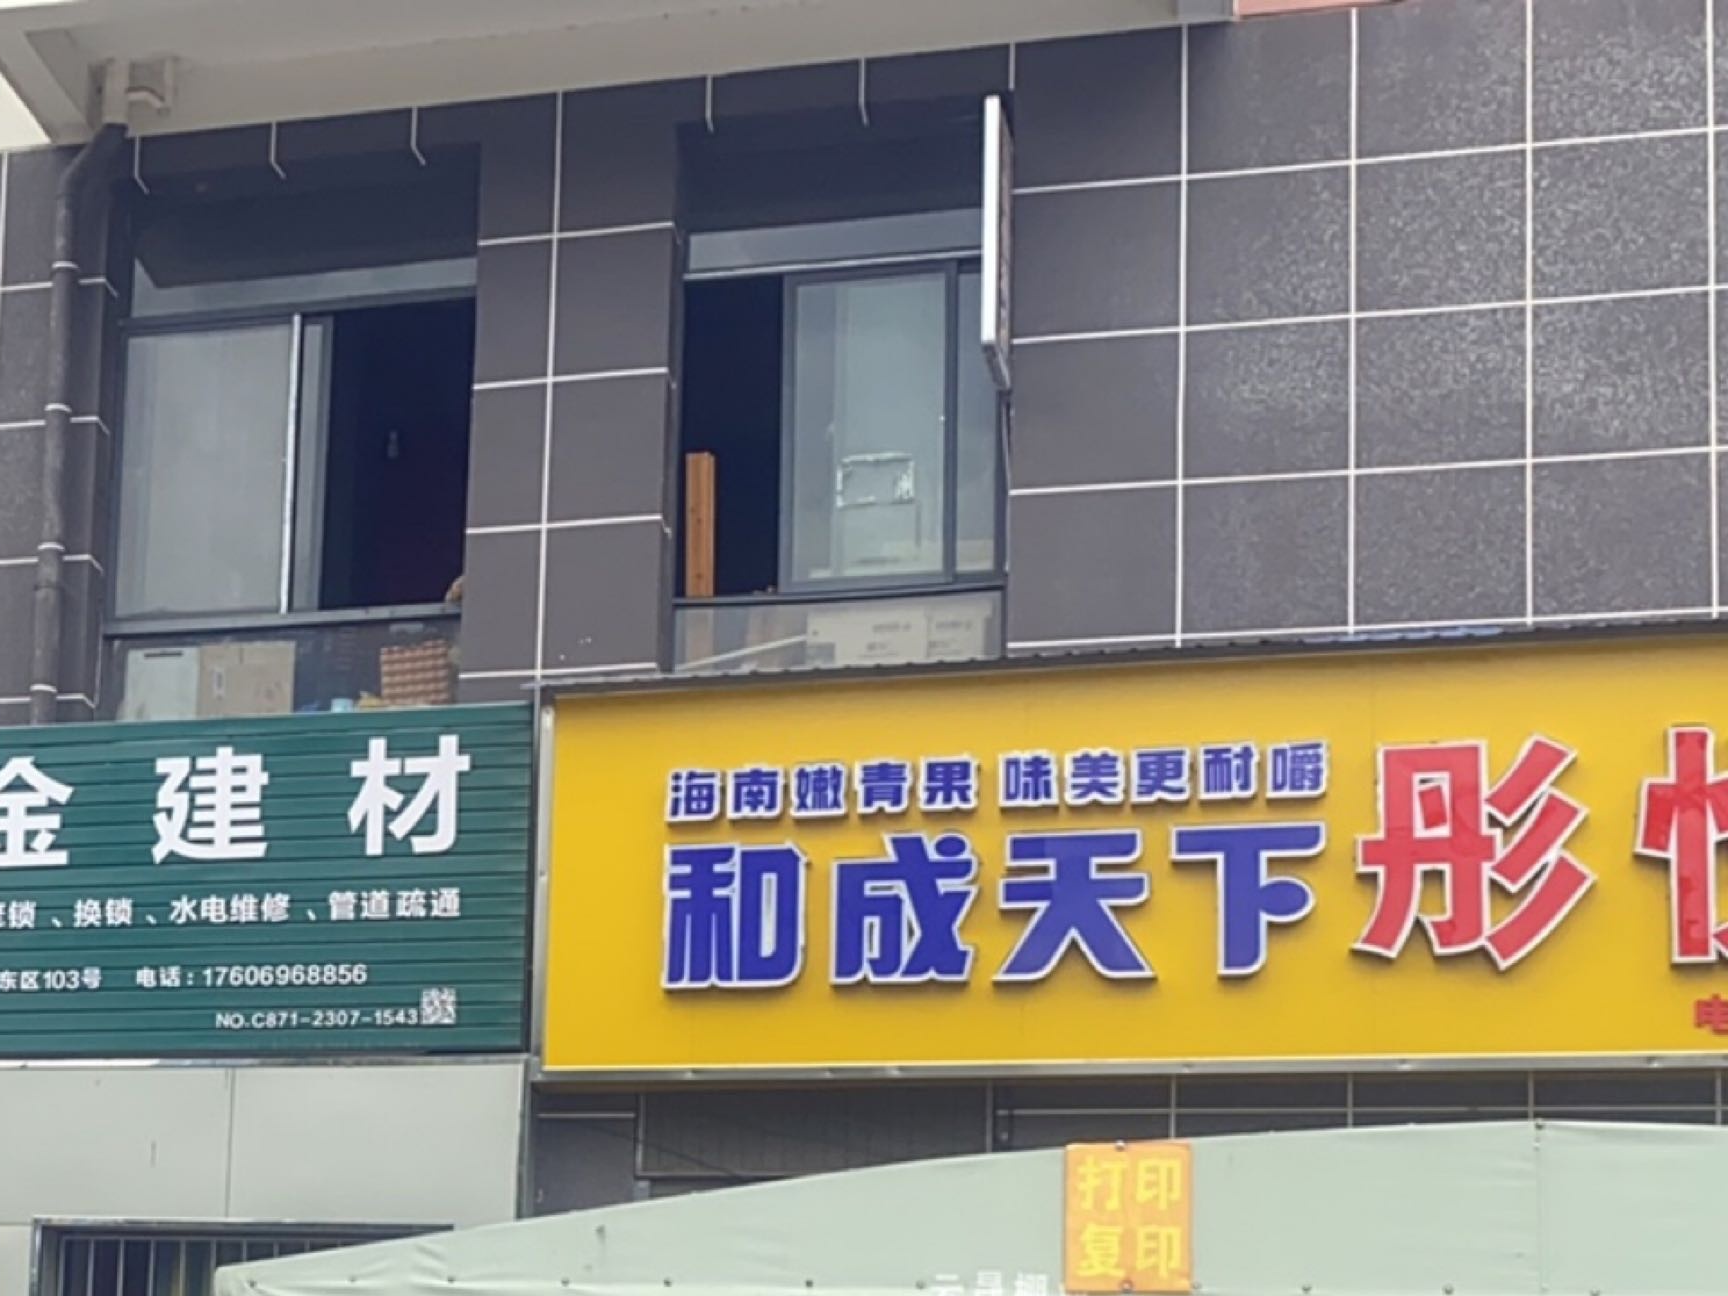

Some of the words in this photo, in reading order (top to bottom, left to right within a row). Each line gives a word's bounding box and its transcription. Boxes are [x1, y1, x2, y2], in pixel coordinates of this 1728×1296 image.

[666, 758, 976, 822] 海南嫩青果
[999, 742, 1330, 808] 味美更耐嚼
[663, 823, 1327, 990] 和成天下
[1077, 1155, 1183, 1212] 打印
[1077, 1222, 1183, 1279] 复印
